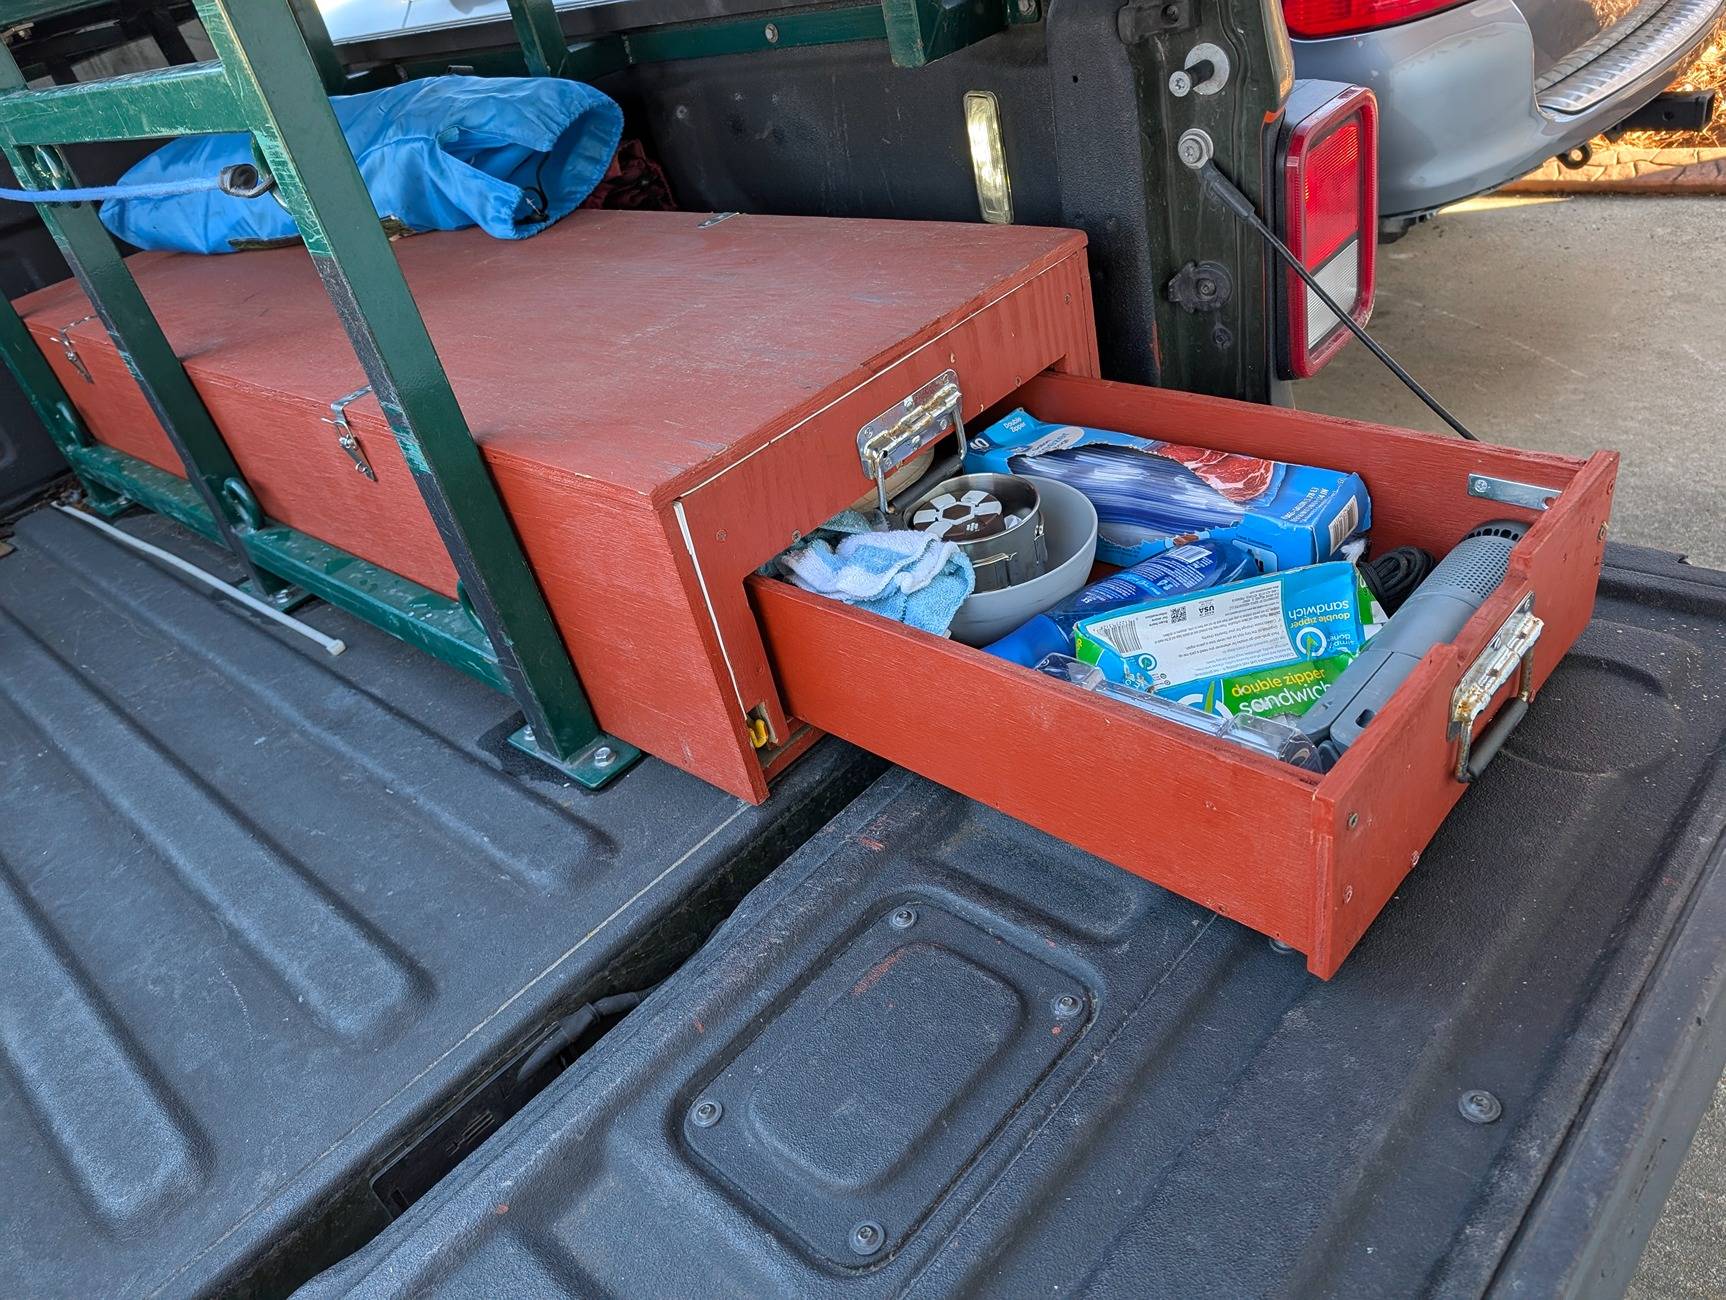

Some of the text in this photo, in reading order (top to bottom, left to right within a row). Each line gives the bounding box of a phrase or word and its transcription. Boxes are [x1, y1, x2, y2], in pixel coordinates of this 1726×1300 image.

[1199, 605, 1215, 614] USA
[1288, 600, 1350, 619] sandwich
[1289, 612, 1351, 629] double zipper
[1232, 669, 1325, 697] double zipper
[1240, 680, 1332, 714] sandwich
